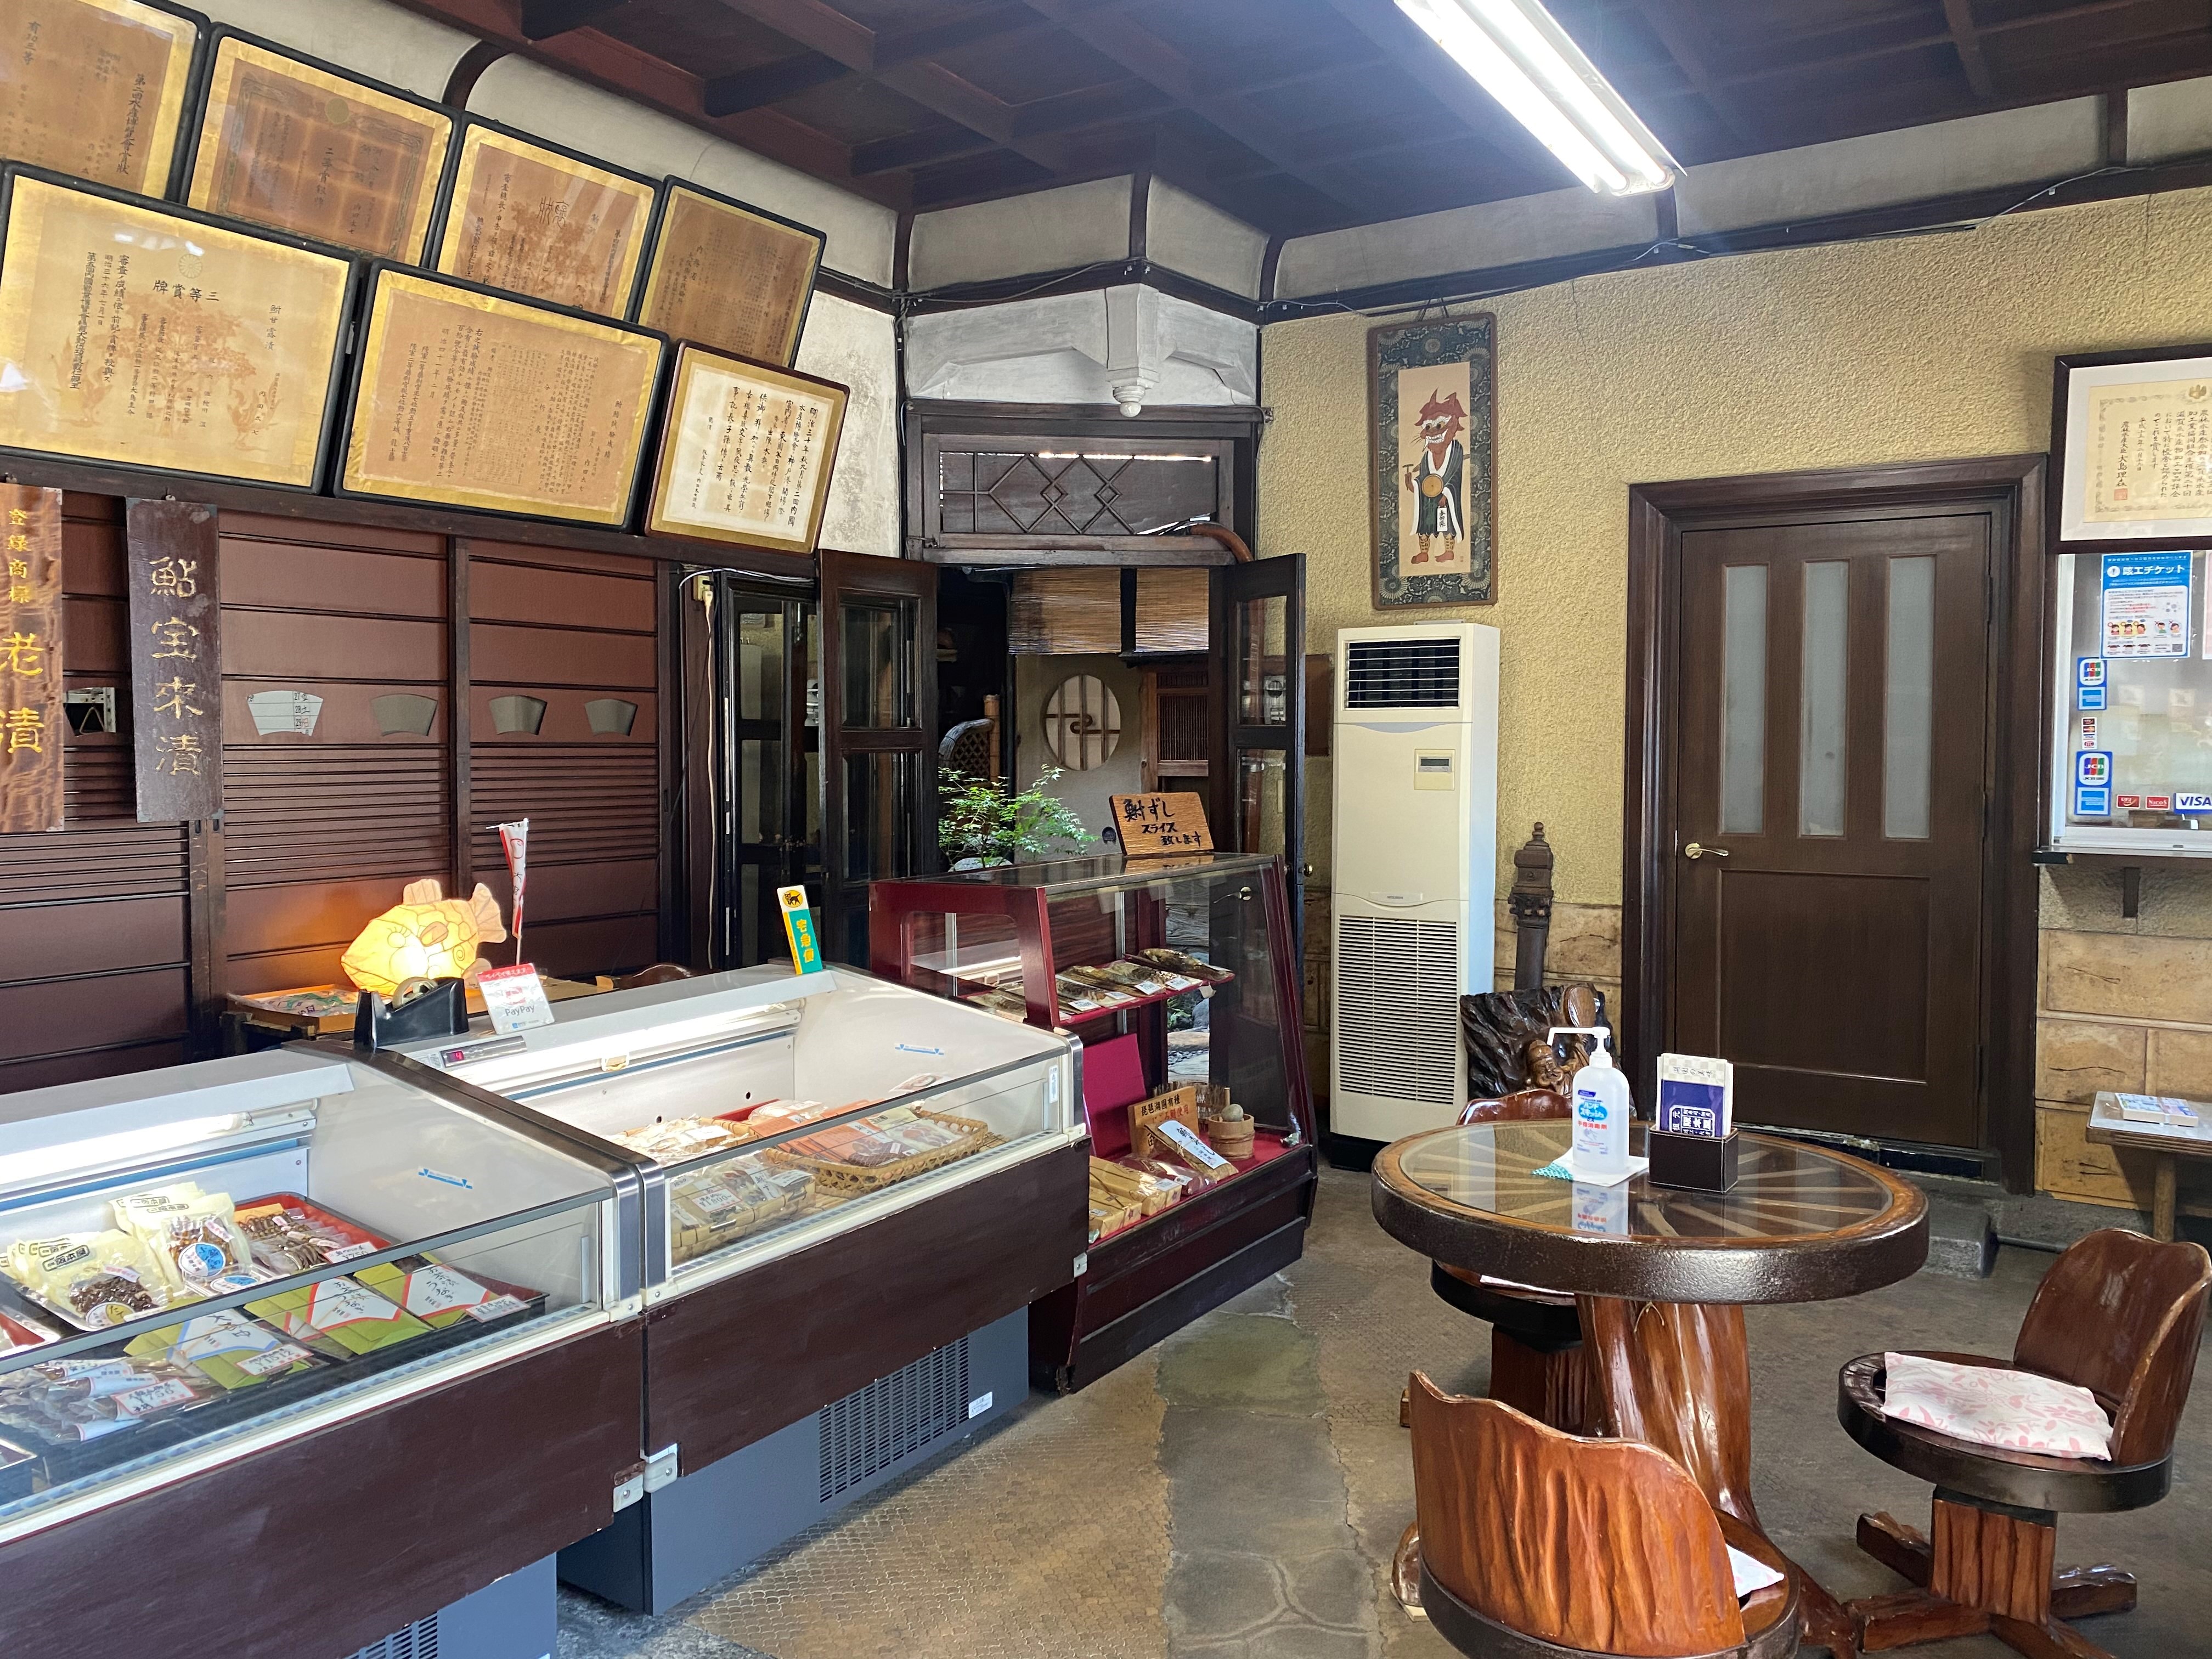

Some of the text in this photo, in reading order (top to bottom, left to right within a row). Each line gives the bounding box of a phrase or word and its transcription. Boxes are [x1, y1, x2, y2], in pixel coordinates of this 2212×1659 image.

[8, 508, 31, 603] 登録商標
[2180, 797, 2212, 806] VISA
[1122, 797, 1175, 822] 鮒ずし
[1141, 822, 1178, 834] スライス
[1161, 831, 1201, 847] 致します
[505, 1005, 535, 1016] PayPay
